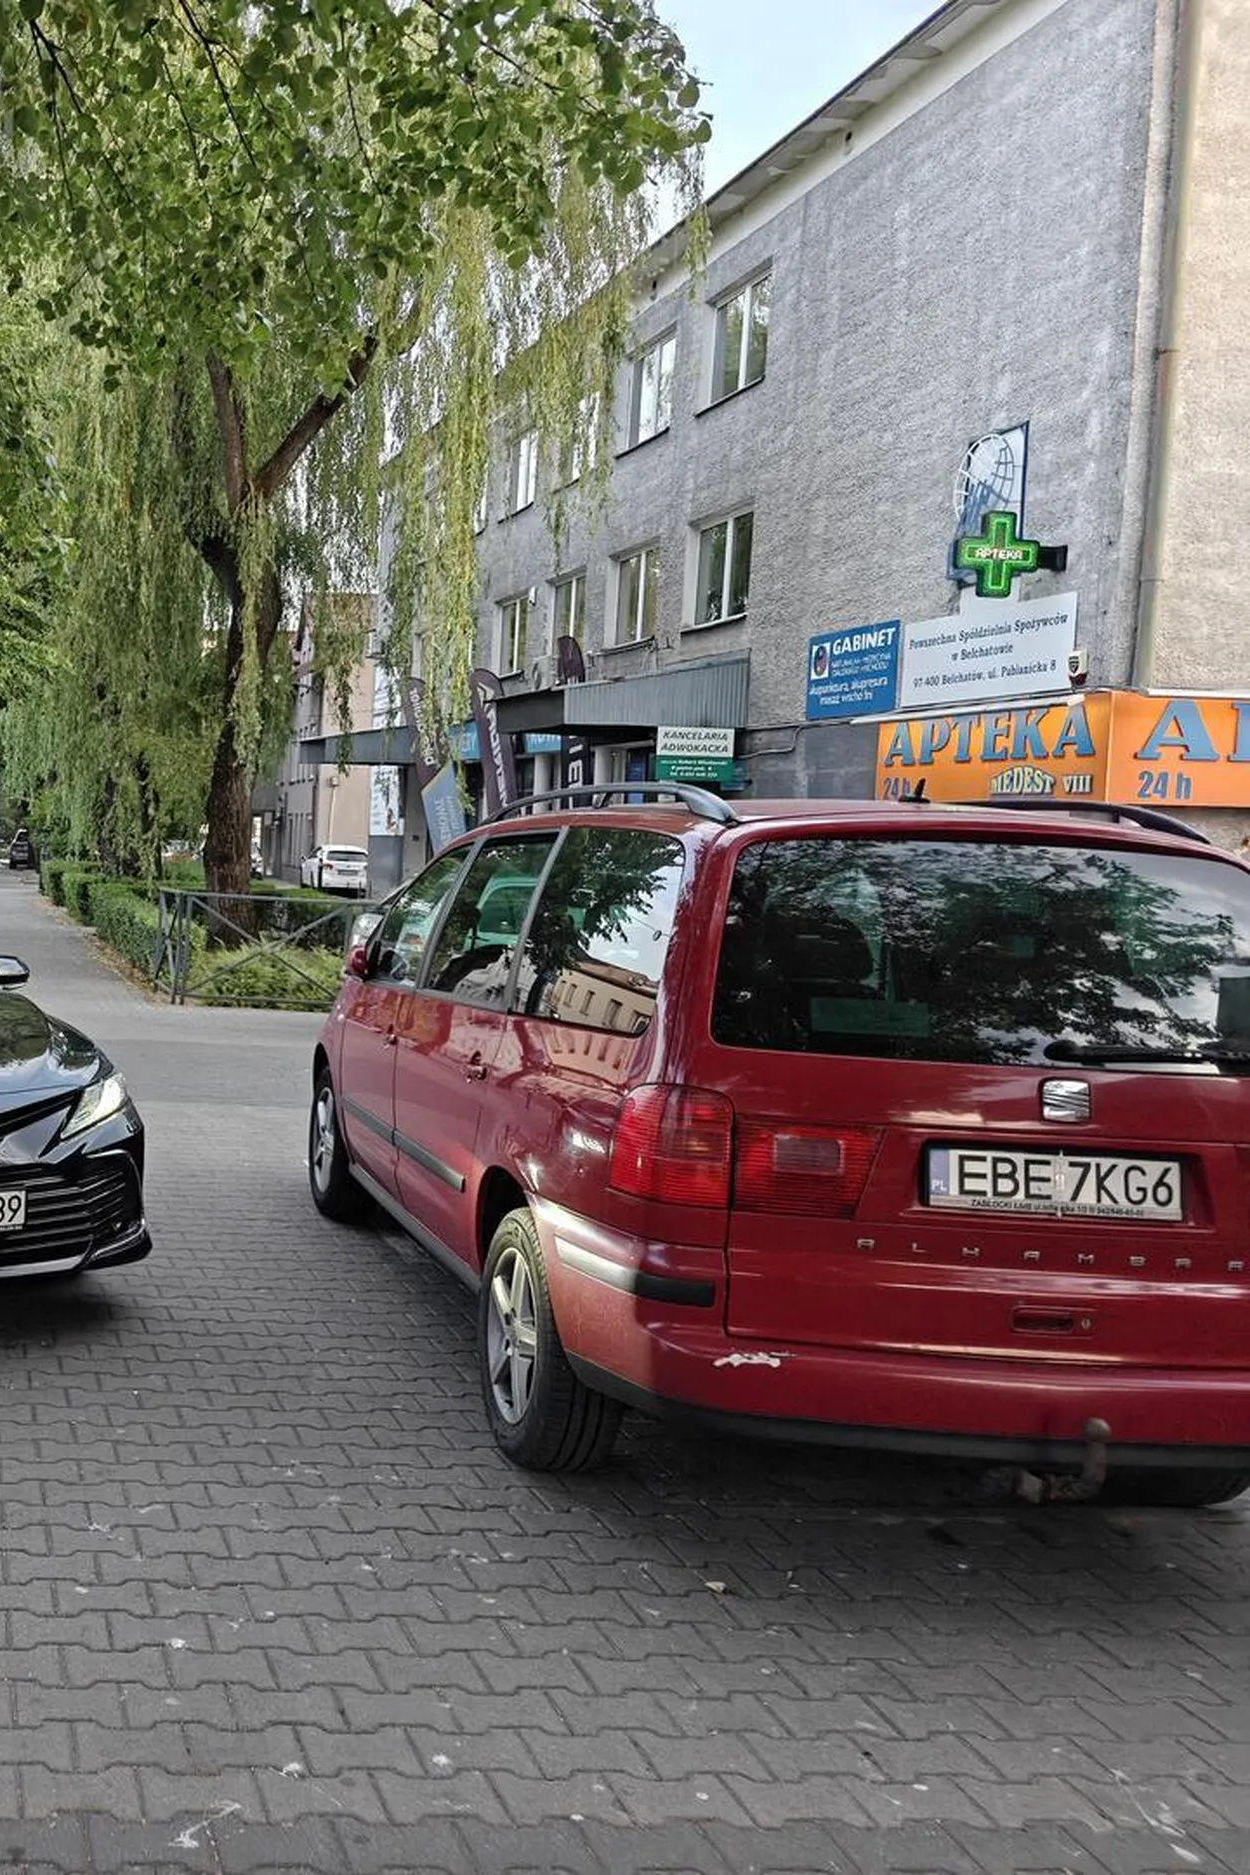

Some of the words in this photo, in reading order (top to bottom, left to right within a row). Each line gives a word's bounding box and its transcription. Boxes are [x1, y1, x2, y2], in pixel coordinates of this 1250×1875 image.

[975, 546, 1023, 560] APTEKA
[833, 627, 896, 655] GABINET
[1050, 659, 1056, 671] 8
[663, 731, 728, 741] KANCELARIA
[883, 703, 1096, 767] APTEKA
[1134, 700, 1250, 762] A
[661, 743, 729, 753] ADWOKACKA
[1063, 774, 1092, 794] VIII
[1138, 771, 1167, 799] 24
[1175, 773, 1191, 799] h
[931, 1179, 947, 1192] PL
[958, 1154, 1052, 1200] EBE
[1068, 1161, 1174, 1208] 7KG6
[857, 1238, 1243, 1271] ALHAMBRA
